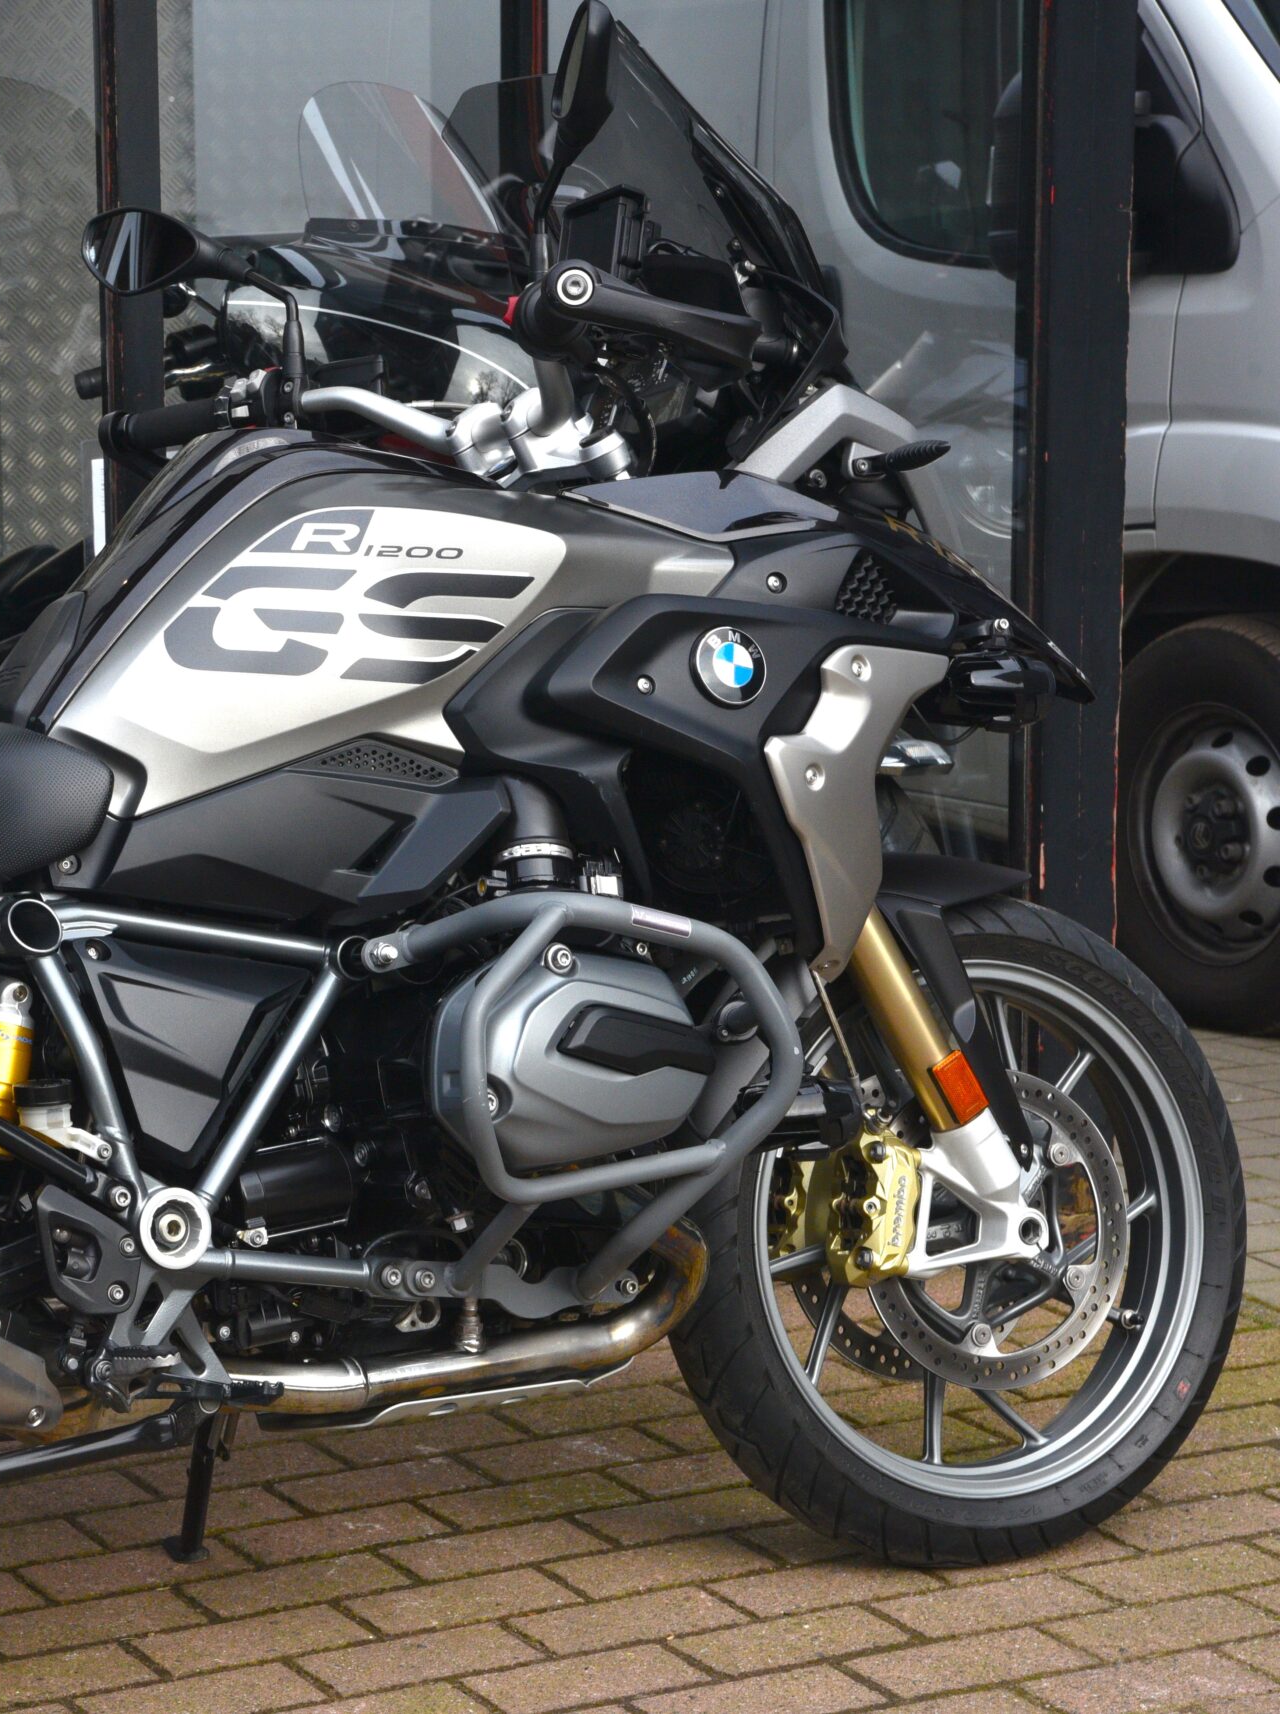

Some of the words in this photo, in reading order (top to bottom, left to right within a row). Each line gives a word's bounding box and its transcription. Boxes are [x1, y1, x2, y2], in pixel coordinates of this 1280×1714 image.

[291, 522, 361, 553] R
[363, 544, 464, 560] 1200
[163, 565, 535, 685] GS
[706, 629, 762, 661] BMW
[887, 1175, 908, 1248] brembo
